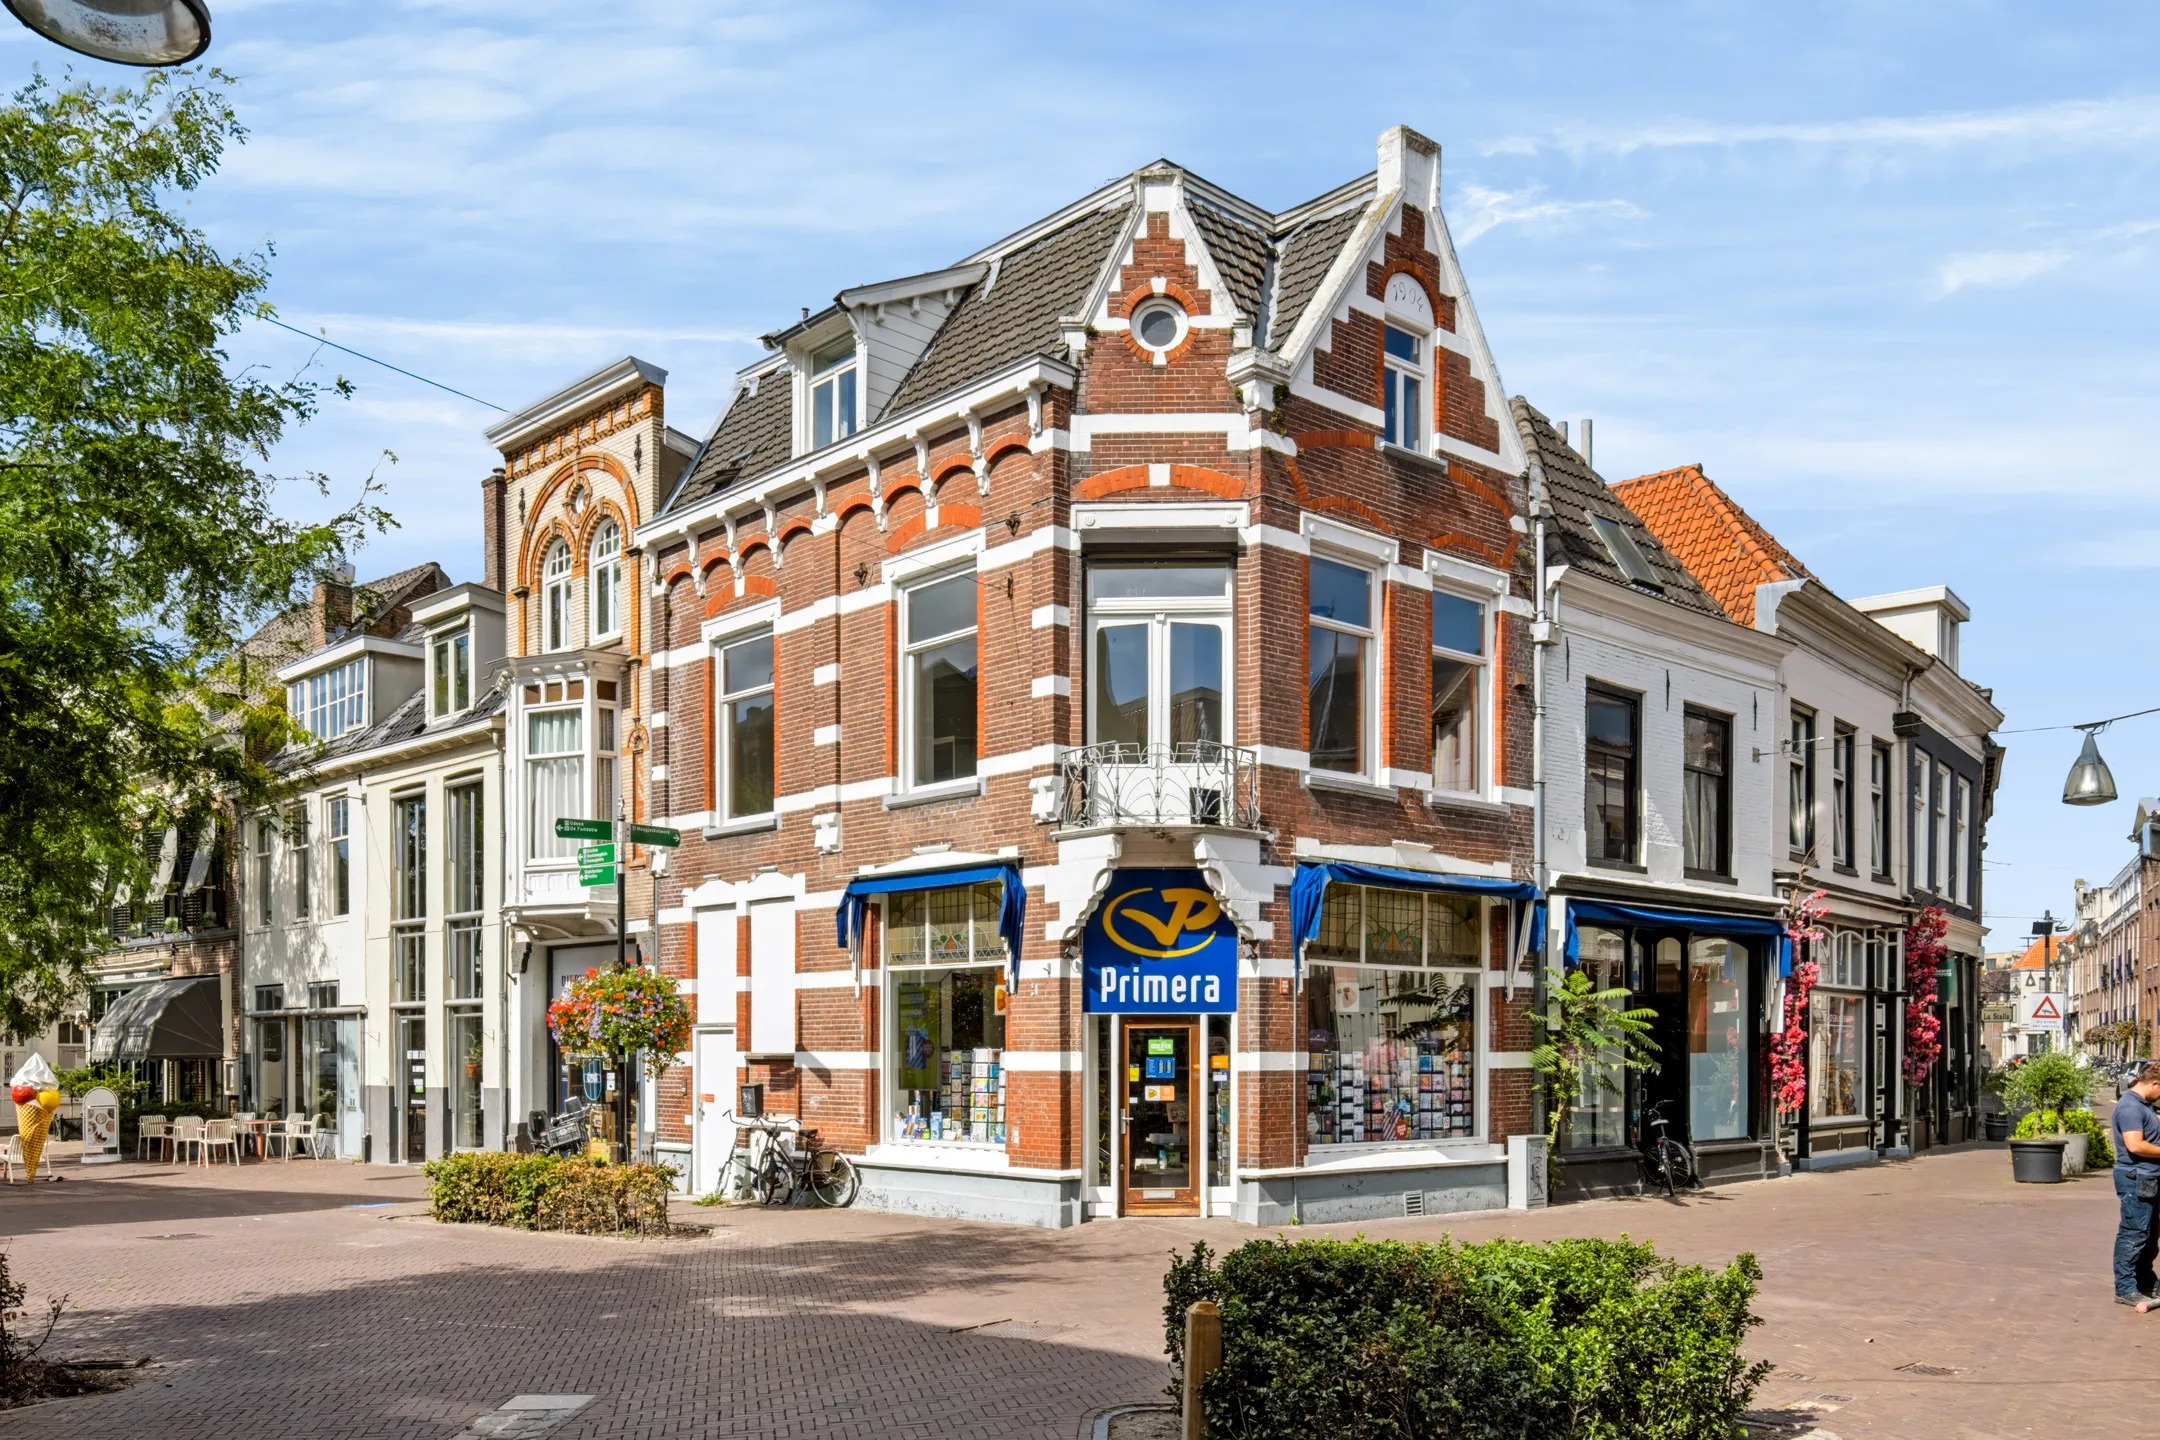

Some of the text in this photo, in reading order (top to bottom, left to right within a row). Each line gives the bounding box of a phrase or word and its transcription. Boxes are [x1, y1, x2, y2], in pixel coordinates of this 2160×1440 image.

[1101, 966, 1220, 1003] Primera
[1983, 1012, 2010, 1021] La Stalla
